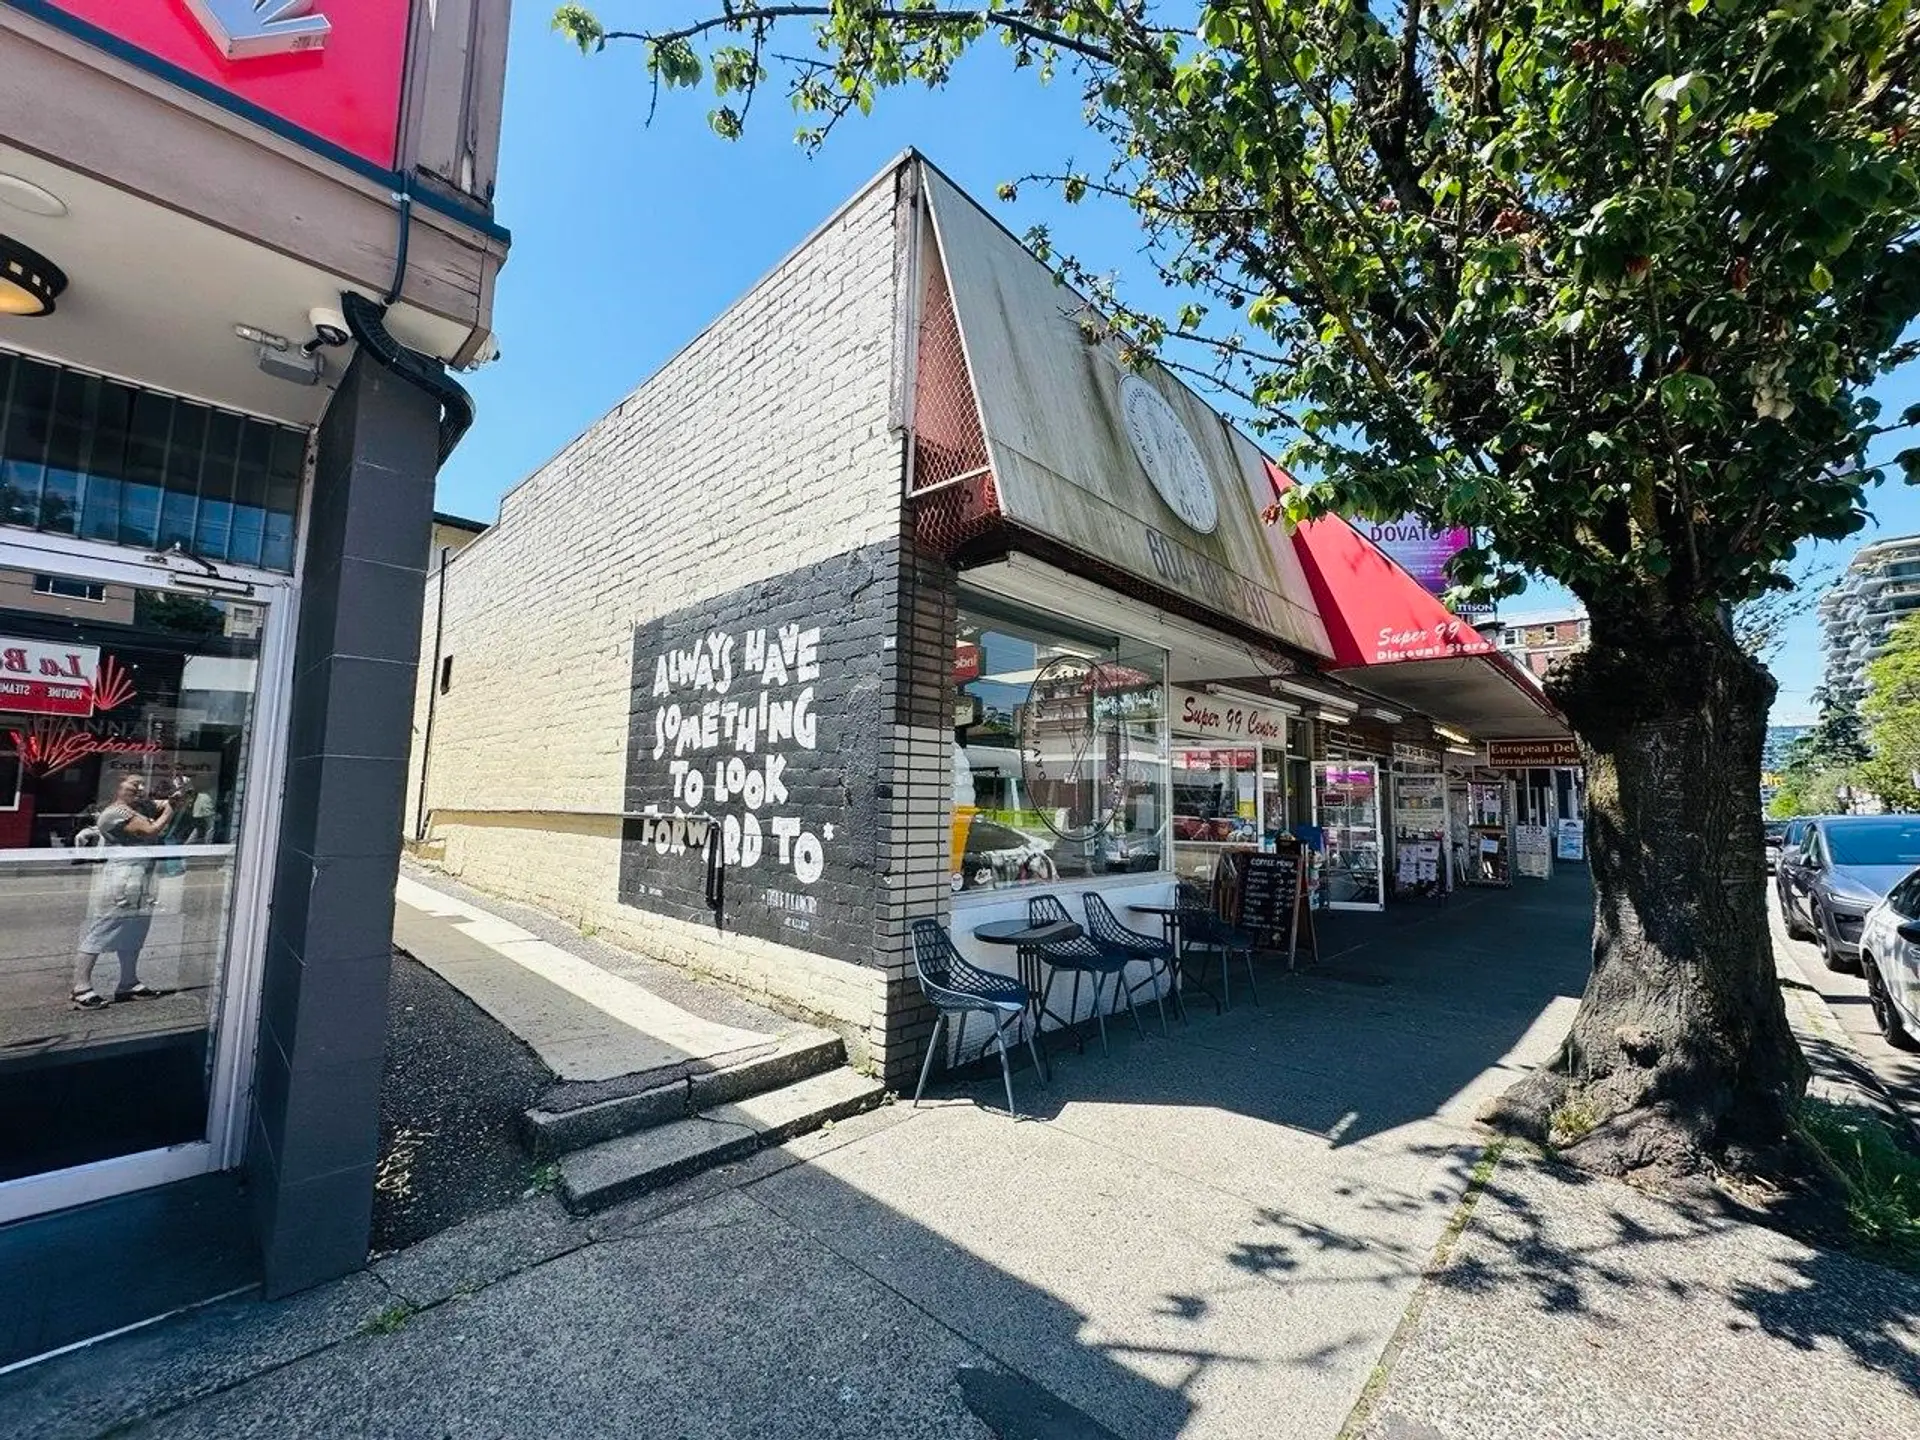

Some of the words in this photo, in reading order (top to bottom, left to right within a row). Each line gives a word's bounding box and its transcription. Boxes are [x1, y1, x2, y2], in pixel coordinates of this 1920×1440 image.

[1377, 626, 1428, 649] Super
[1435, 621, 1461, 640] 99
[652, 629, 734, 698] ALWAYS
[745, 623, 820, 687] HAVE
[1377, 646, 1440, 661] Discount
[653, 686, 817, 761] SOMETHING
[1182, 696, 1220, 734] Super
[1226, 708, 1243, 734] 99
[1248, 710, 1279, 739] Centre
[1491, 744, 1549, 756] European
[1553, 742, 1576, 754] Del
[1491, 757, 1554, 766] International
[669, 760, 703, 809] TO
[715, 754, 789, 810] LOOK
[1250, 858, 1275, 867] COFFEE
[1276, 859, 1294, 868] MENU
